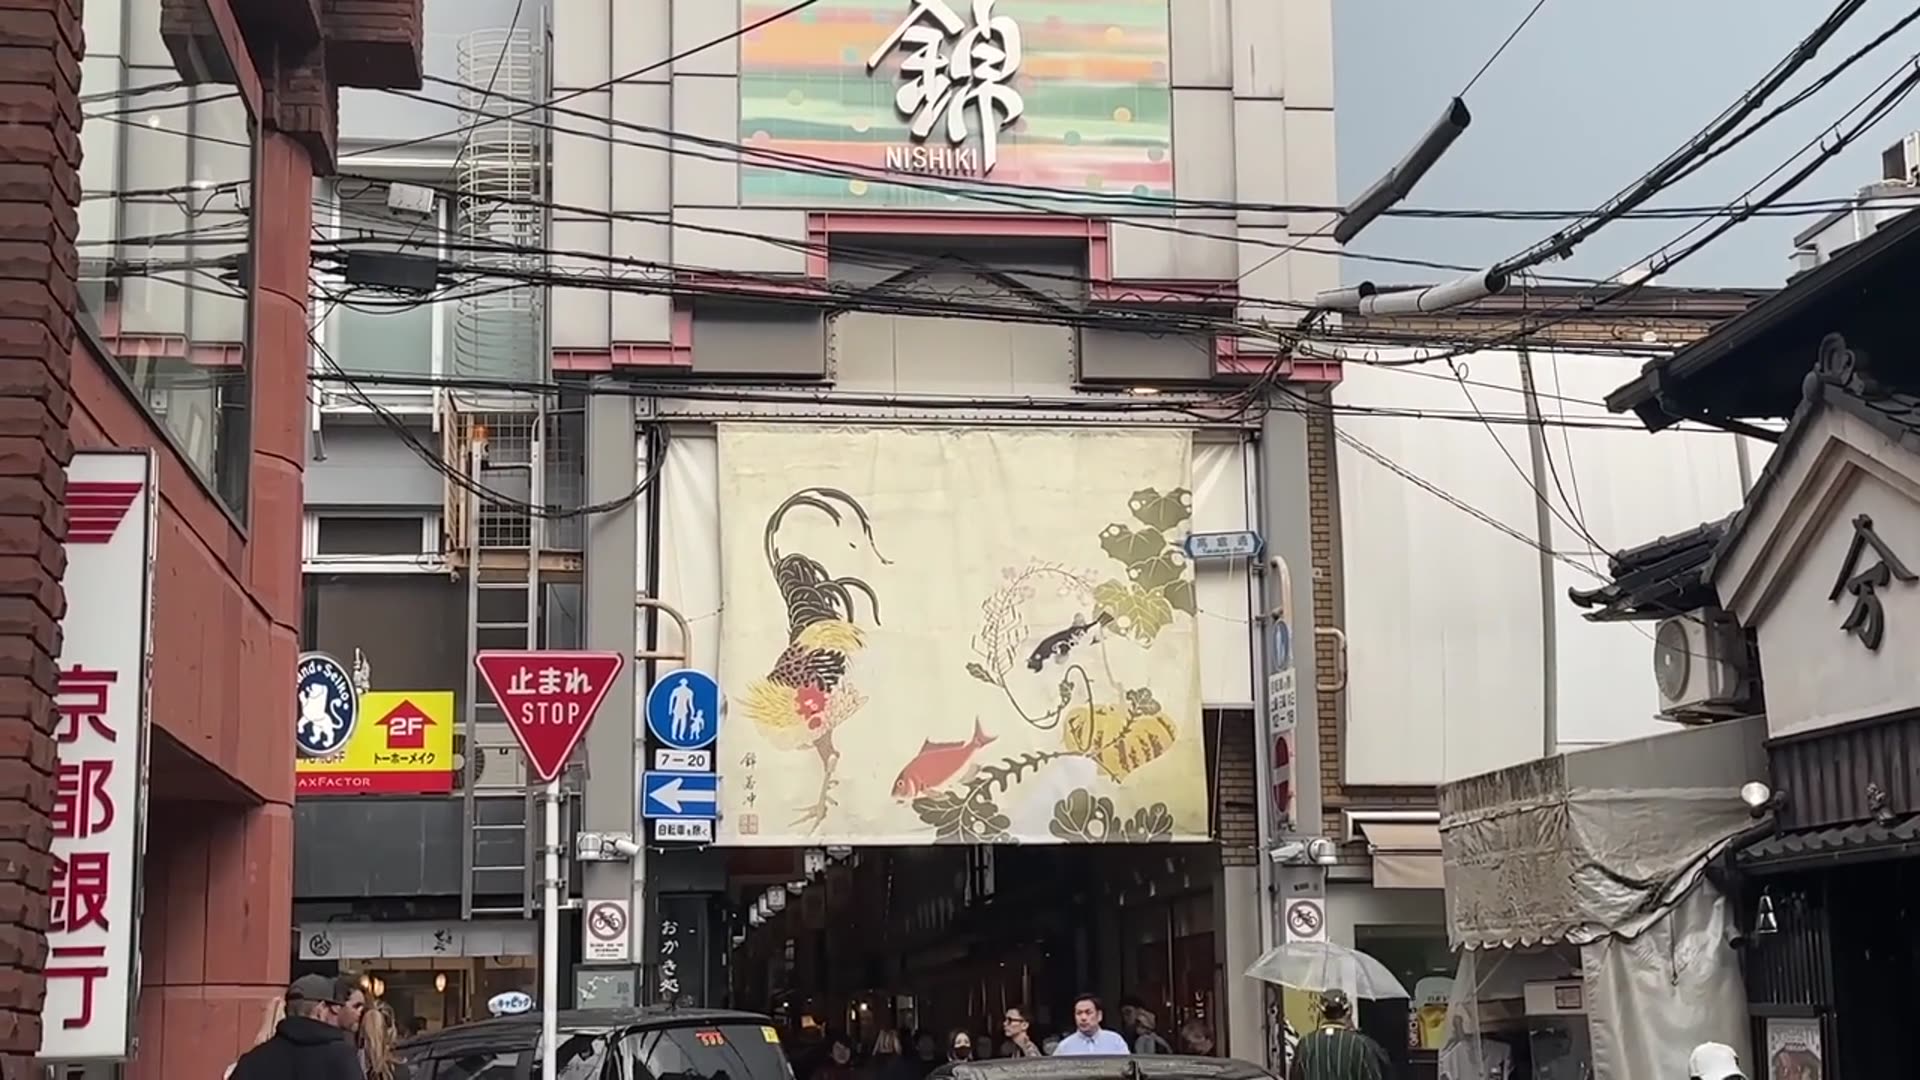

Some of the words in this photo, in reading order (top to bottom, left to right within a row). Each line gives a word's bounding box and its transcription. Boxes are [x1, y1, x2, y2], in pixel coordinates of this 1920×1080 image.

[867, 0, 1024, 177] 錦
[886, 146, 979, 171] NISHIKI
[507, 666, 593, 694] 止まれ
[522, 702, 580, 725] STOP
[390, 717, 424, 736] 2F
[374, 752, 436, 765] トーホーメイク
[659, 920, 679, 993] おかき処
